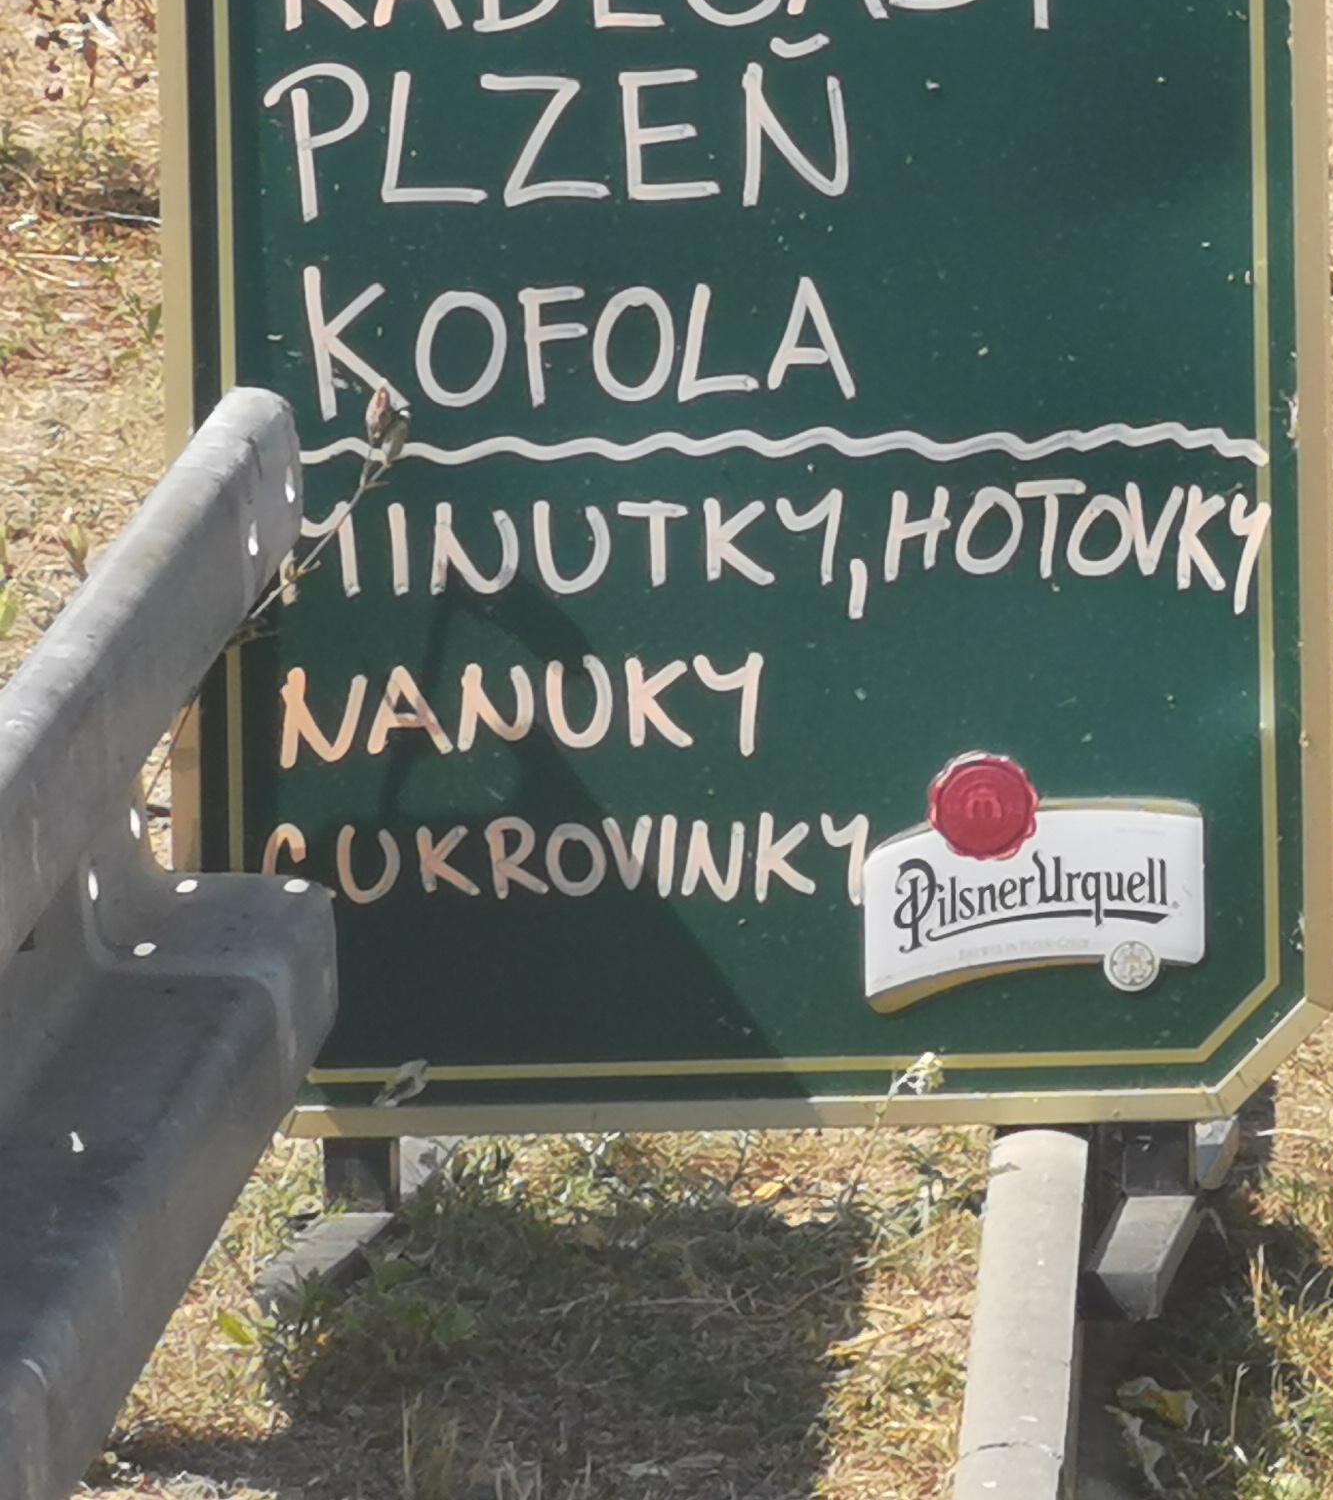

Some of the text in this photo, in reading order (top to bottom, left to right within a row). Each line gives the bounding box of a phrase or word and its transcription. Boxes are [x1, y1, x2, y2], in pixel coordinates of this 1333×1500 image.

[263, 32, 851, 222] PLZEŇ
[304, 265, 856, 420] KOFOLA
[278, 651, 764, 769] NANUKY
[893, 850, 1168, 954] Pilsner Urquell
